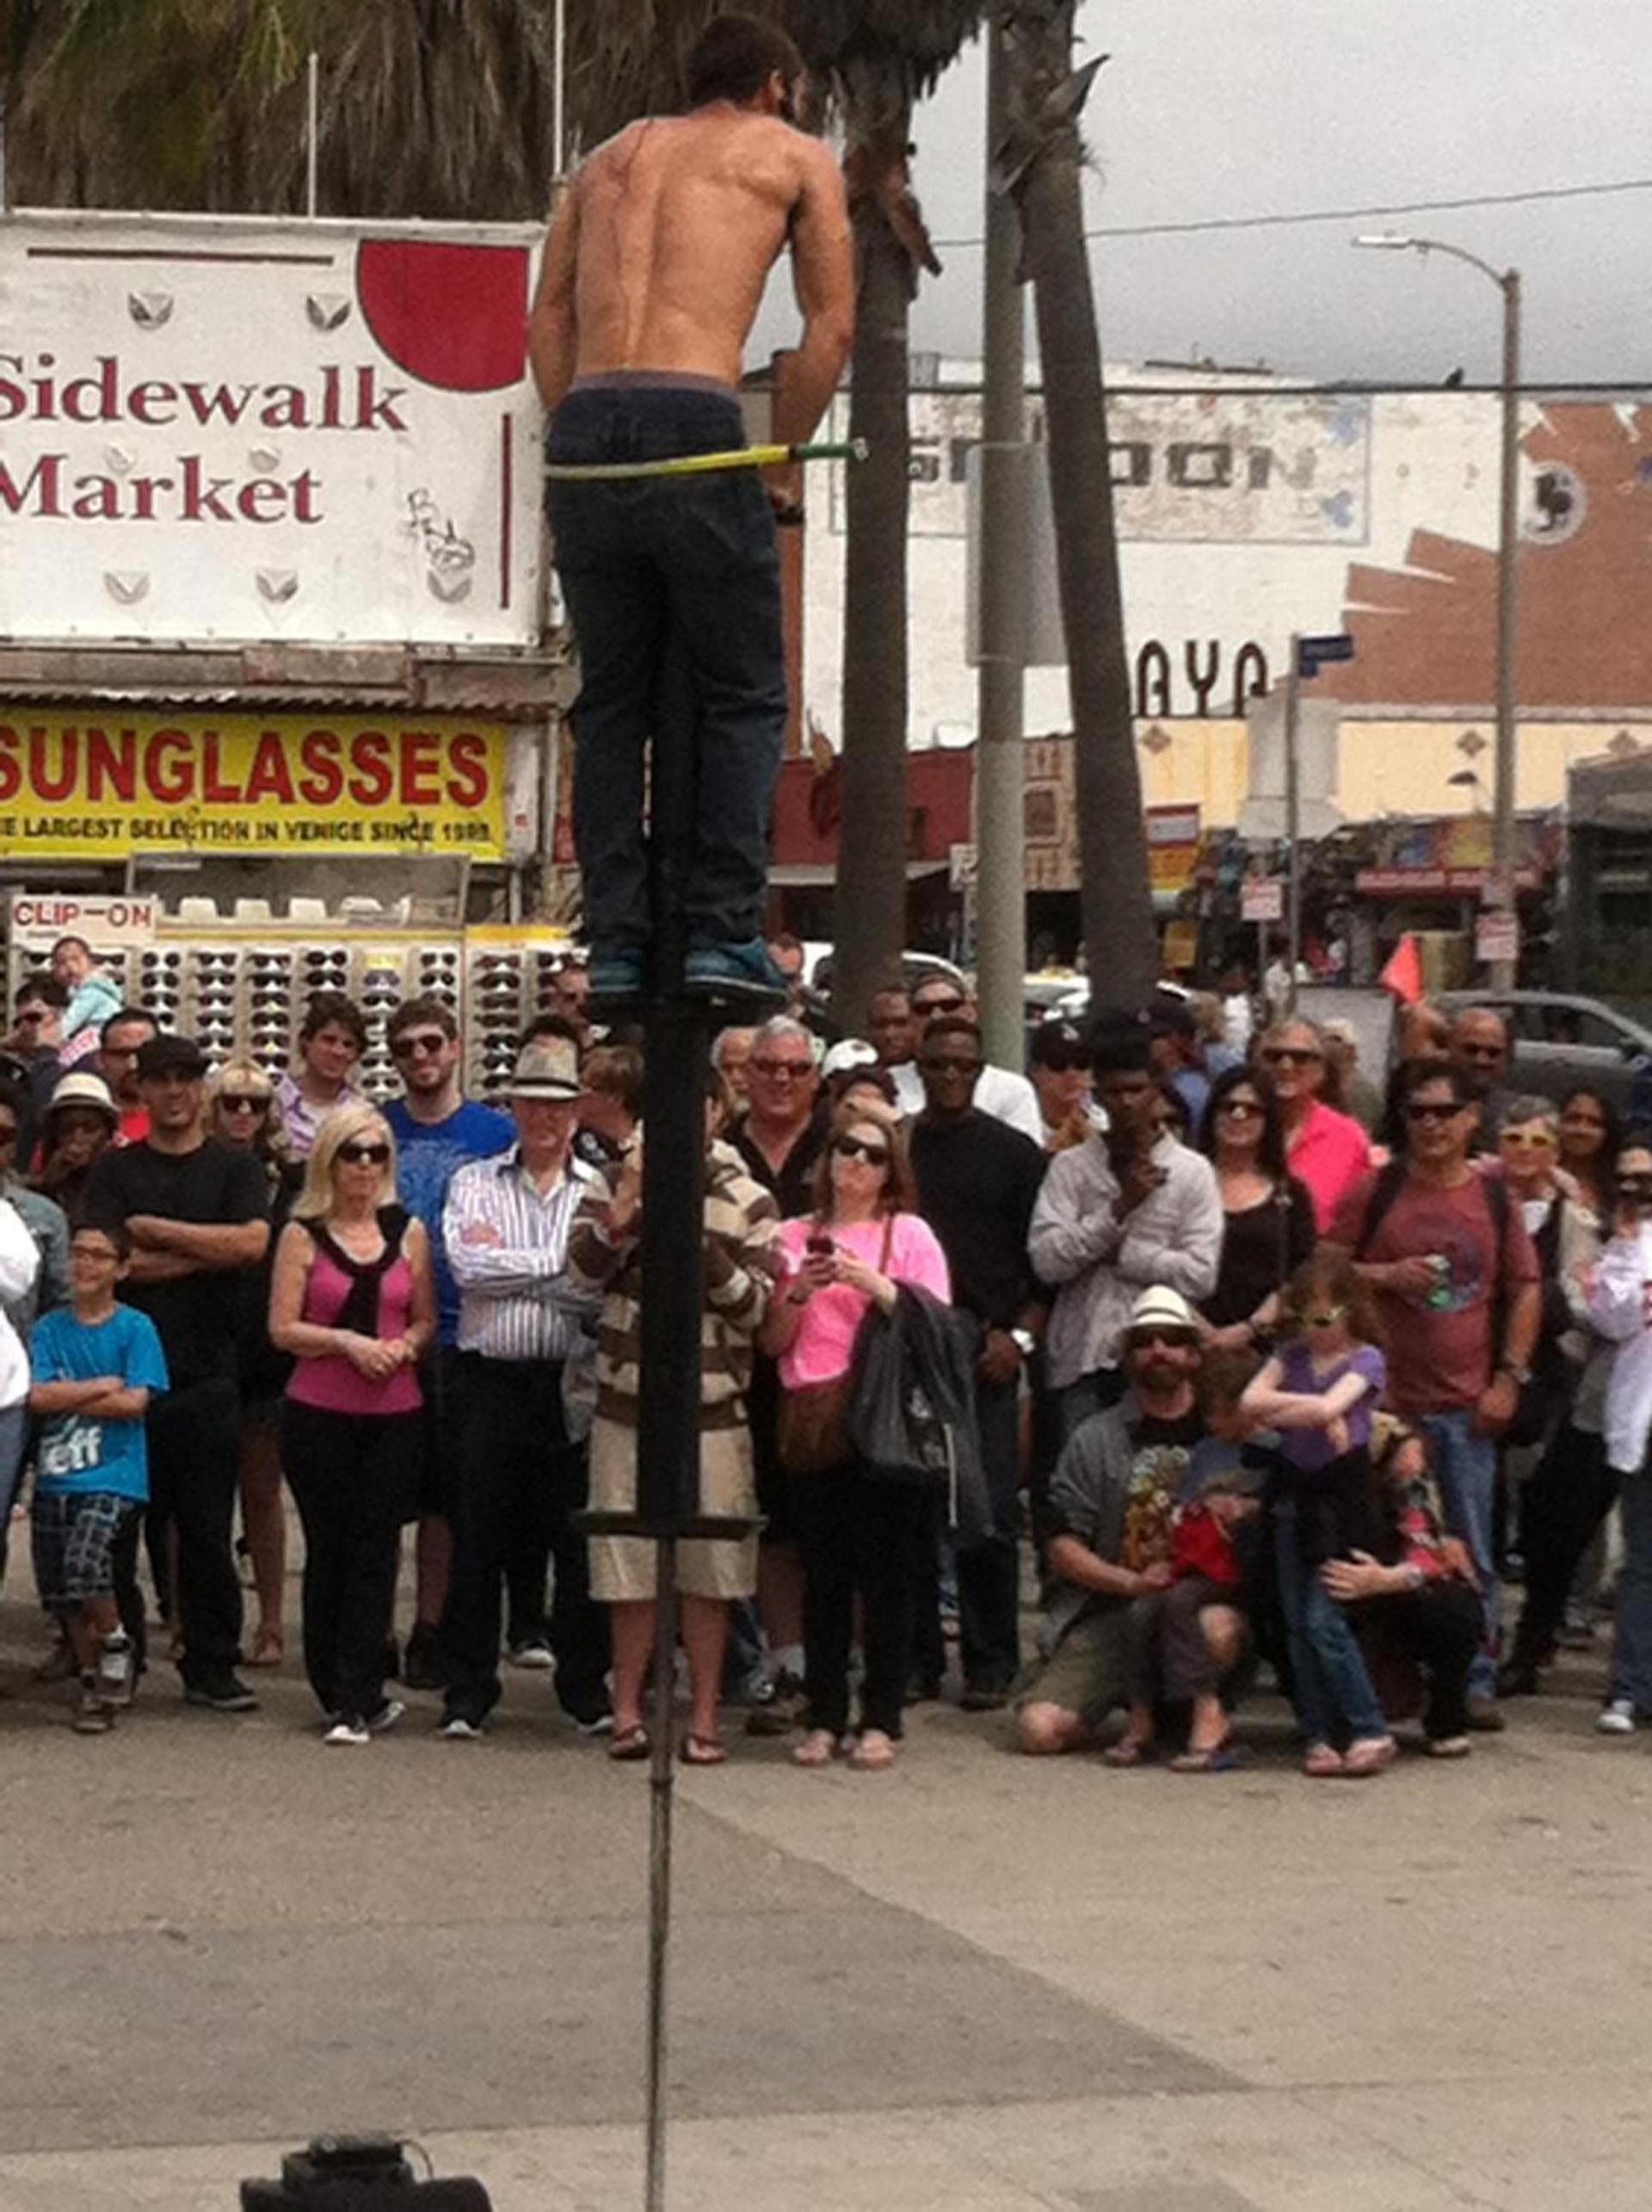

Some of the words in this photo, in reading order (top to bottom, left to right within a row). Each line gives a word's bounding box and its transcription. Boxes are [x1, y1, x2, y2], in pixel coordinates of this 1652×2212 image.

[0, 354, 410, 430] Sidewalk
[0, 453, 323, 523] Market
[0, 727, 489, 807] SUNGLASSES
[23, 817, 123, 839] LARGEST
[130, 818, 250, 841] SELECTION
[256, 821, 279, 841] IN
[285, 821, 363, 841] VENICE
[371, 821, 434, 841] SINCE
